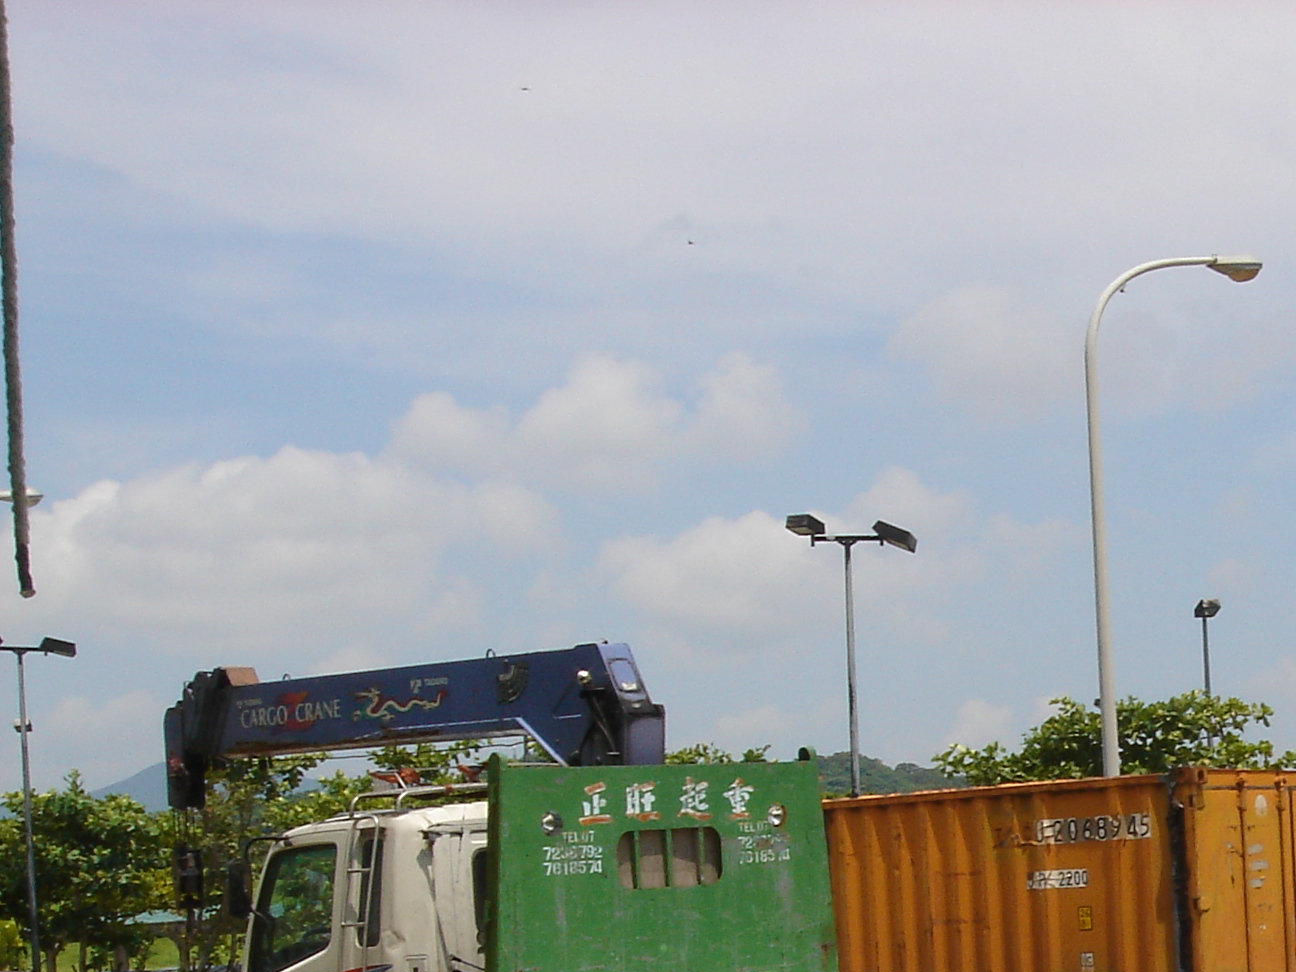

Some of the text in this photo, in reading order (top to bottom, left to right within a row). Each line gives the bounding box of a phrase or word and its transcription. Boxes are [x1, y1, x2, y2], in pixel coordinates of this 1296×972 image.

[241, 699, 342, 728] CARGO CRANE
[738, 822, 755, 832] TEL
[562, 832, 579, 843] TEL
